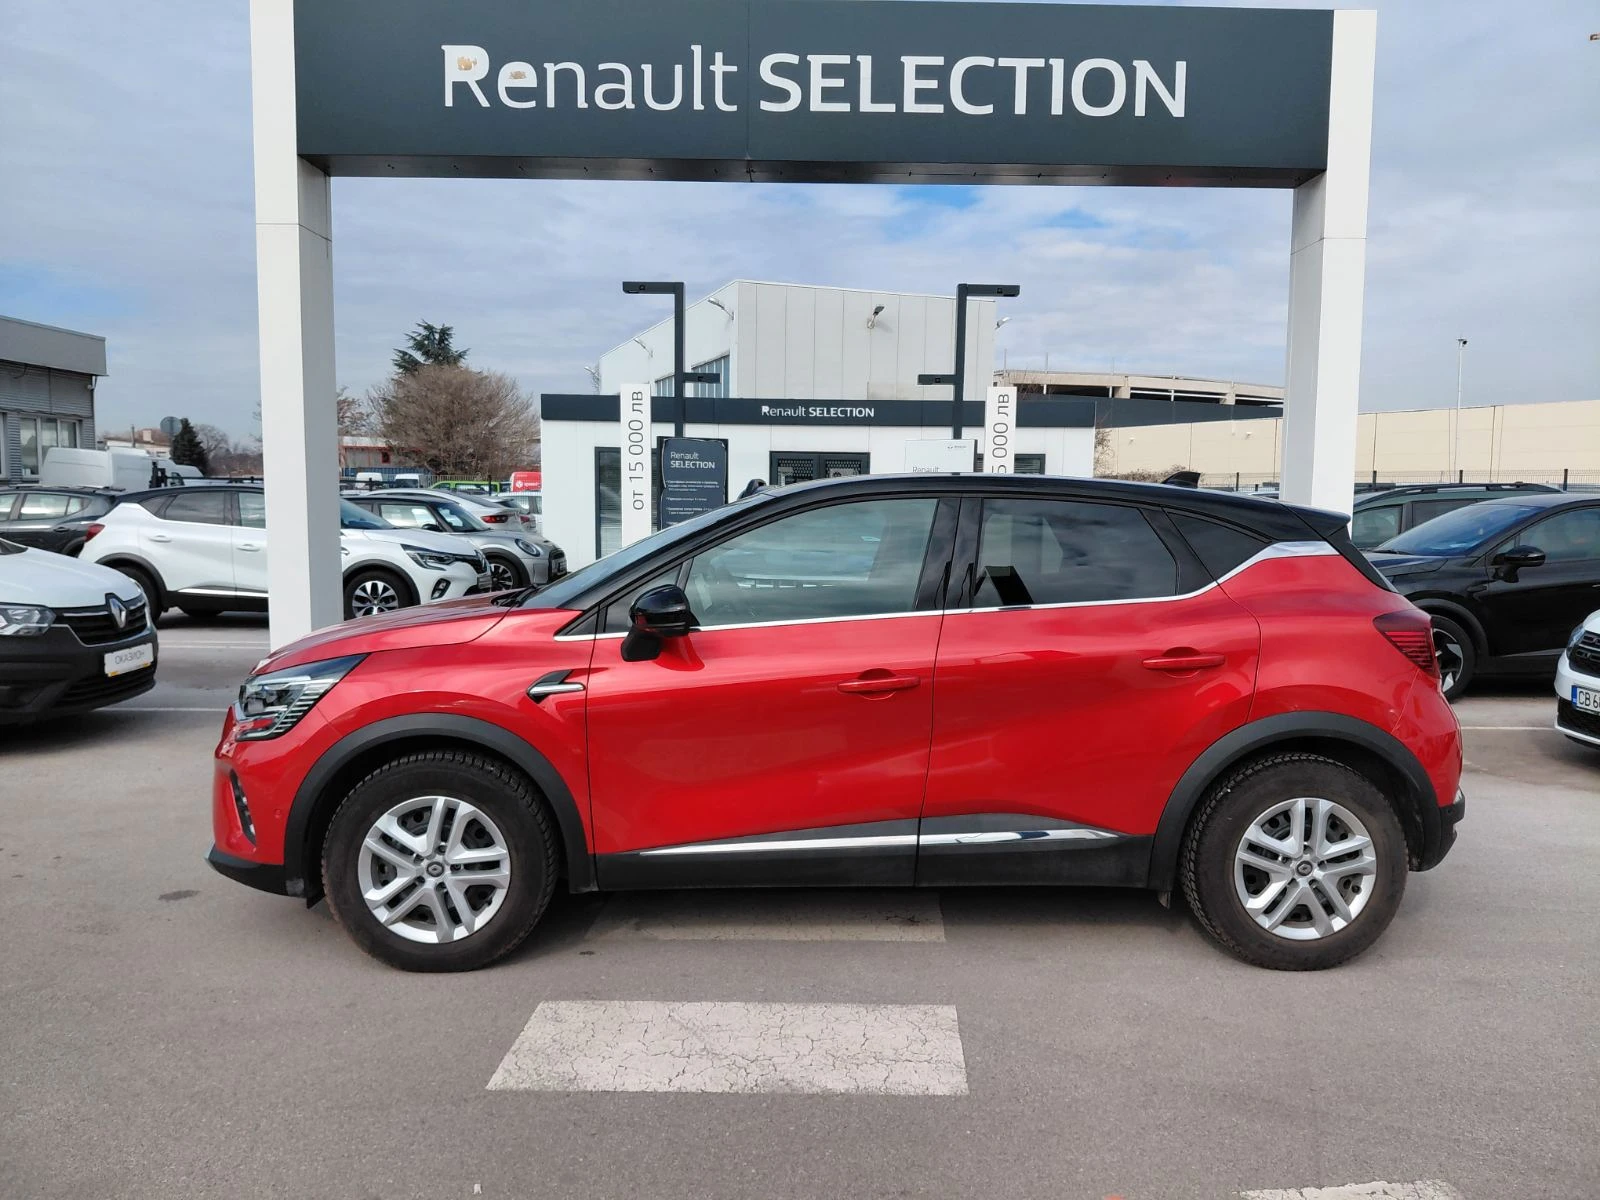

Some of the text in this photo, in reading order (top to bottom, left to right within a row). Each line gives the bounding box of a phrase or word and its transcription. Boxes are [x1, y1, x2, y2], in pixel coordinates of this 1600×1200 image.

[441, 44, 1188, 119] Renault SELECTION
[761, 405, 875, 418] Renault SELECTION
[628, 419, 644, 456] 000
[992, 422, 1009, 459] 000
[670, 451, 700, 460] Renault
[670, 460, 716, 469] SELECTION
[629, 461, 644, 483] 15
[1593, 693, 1600, 709] 6
